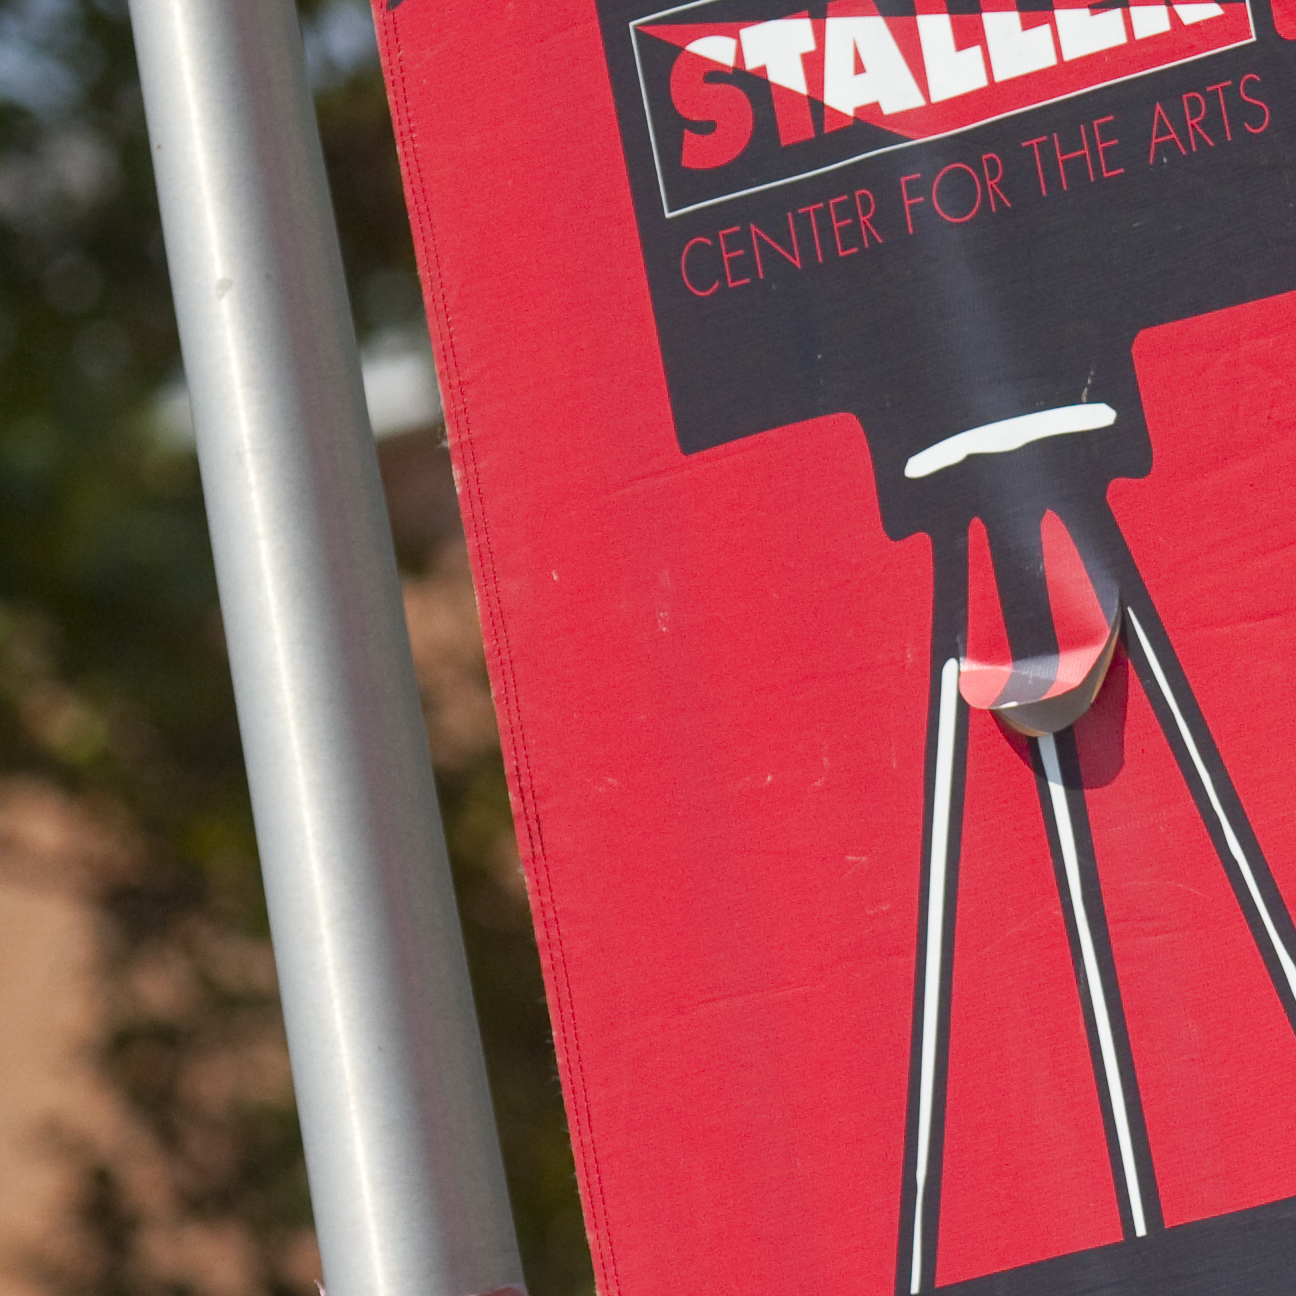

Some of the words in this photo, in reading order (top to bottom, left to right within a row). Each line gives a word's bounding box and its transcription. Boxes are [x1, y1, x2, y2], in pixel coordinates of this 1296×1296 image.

[681, 189, 882, 297] CENTER
[899, 153, 1011, 236] FOR
[1022, 116, 1124, 197] THE
[1148, 74, 1271, 165] ARTS
